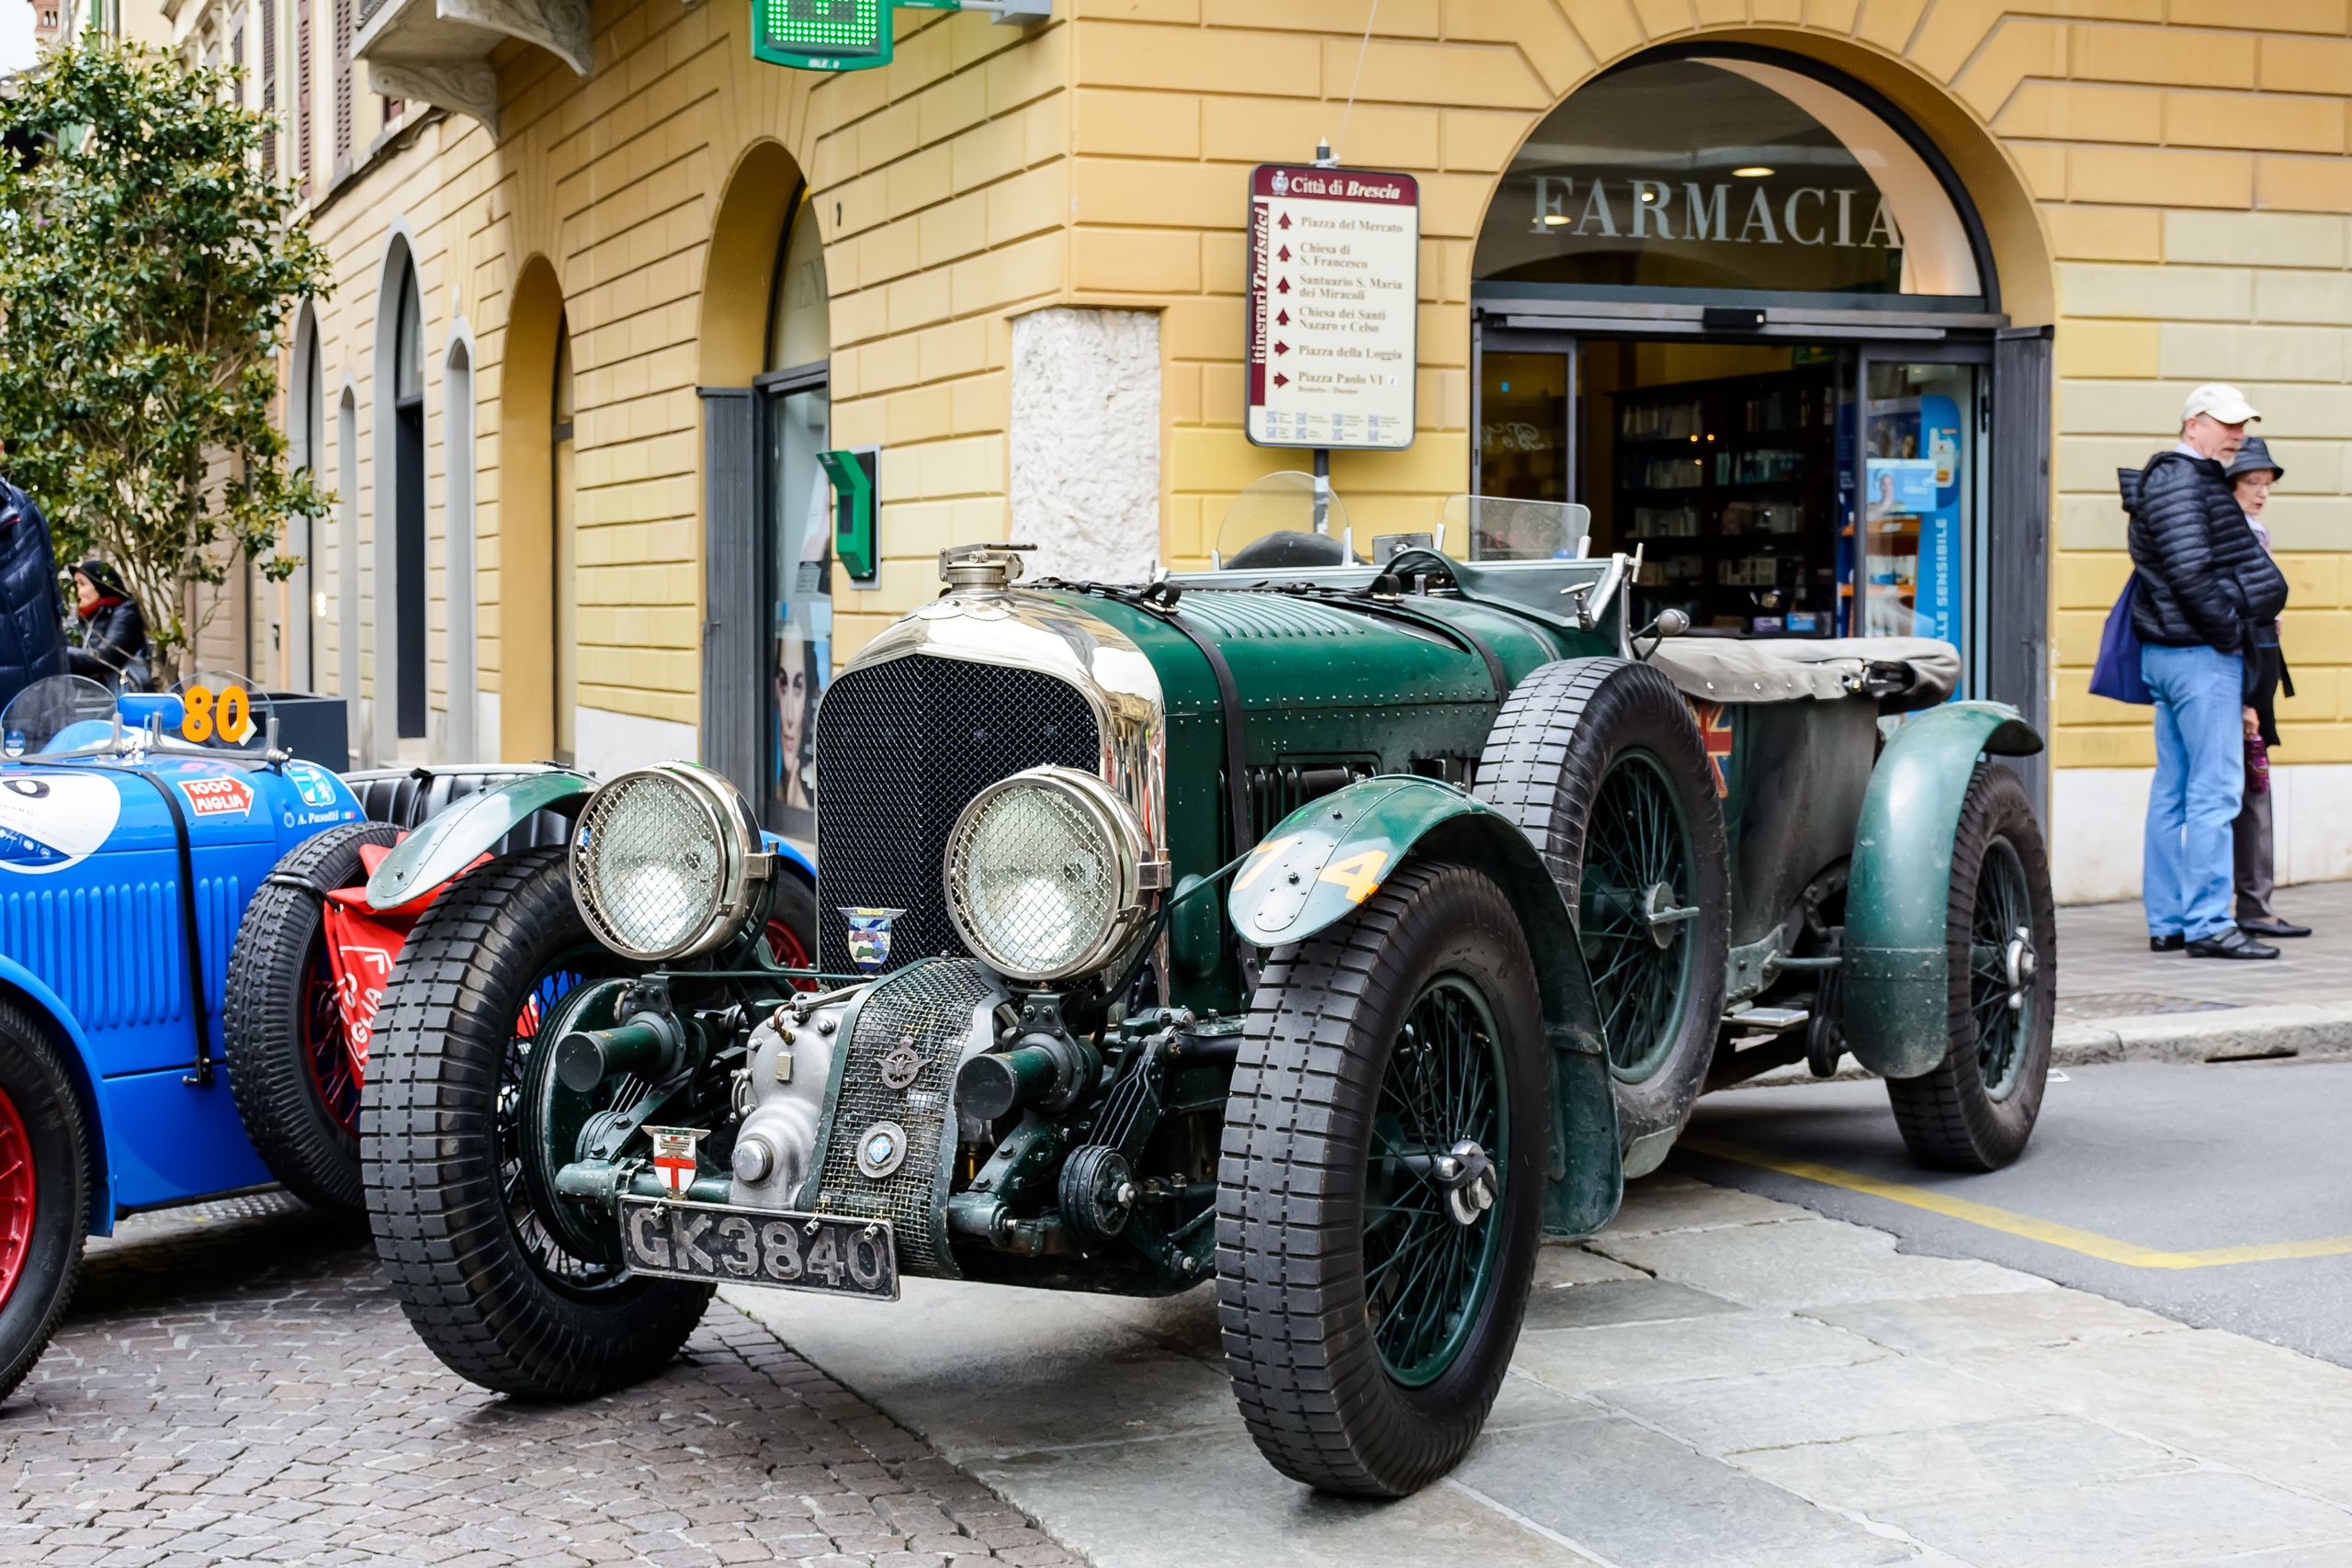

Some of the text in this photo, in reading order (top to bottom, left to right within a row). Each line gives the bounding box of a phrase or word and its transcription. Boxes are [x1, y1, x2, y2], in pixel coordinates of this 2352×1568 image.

[1291, 174, 1401, 199] Città di Brescia
[1528, 175, 1904, 249] FARMACIA
[1301, 217, 1403, 232] Piazza del Mercato
[1300, 243, 1351, 255] Chiesa di
[1314, 256, 1368, 268] Francesco
[1251, 207, 1268, 365] itinerari Turistici
[1299, 275, 1353, 286] Santuario
[1370, 278, 1402, 290] Maria
[1299, 288, 1365, 300] dei Miracoli
[1299, 307, 1386, 321] Chiesa dei Santi
[1299, 319, 1338, 331] Nazaro
[1350, 321, 1379, 333] Celso
[1299, 345, 1402, 361] Piazza della Loggia
[1298, 372, 1332, 383] Piazza
[1337, 373, 1366, 384] Paolo
[1936, 519, 1948, 607] SENSIBILE
[182, 685, 250, 742] 80
[189, 782, 233, 795] 1000
[196, 795, 244, 812] MIGLIA
[629, 1207, 888, 1291] GK3840
